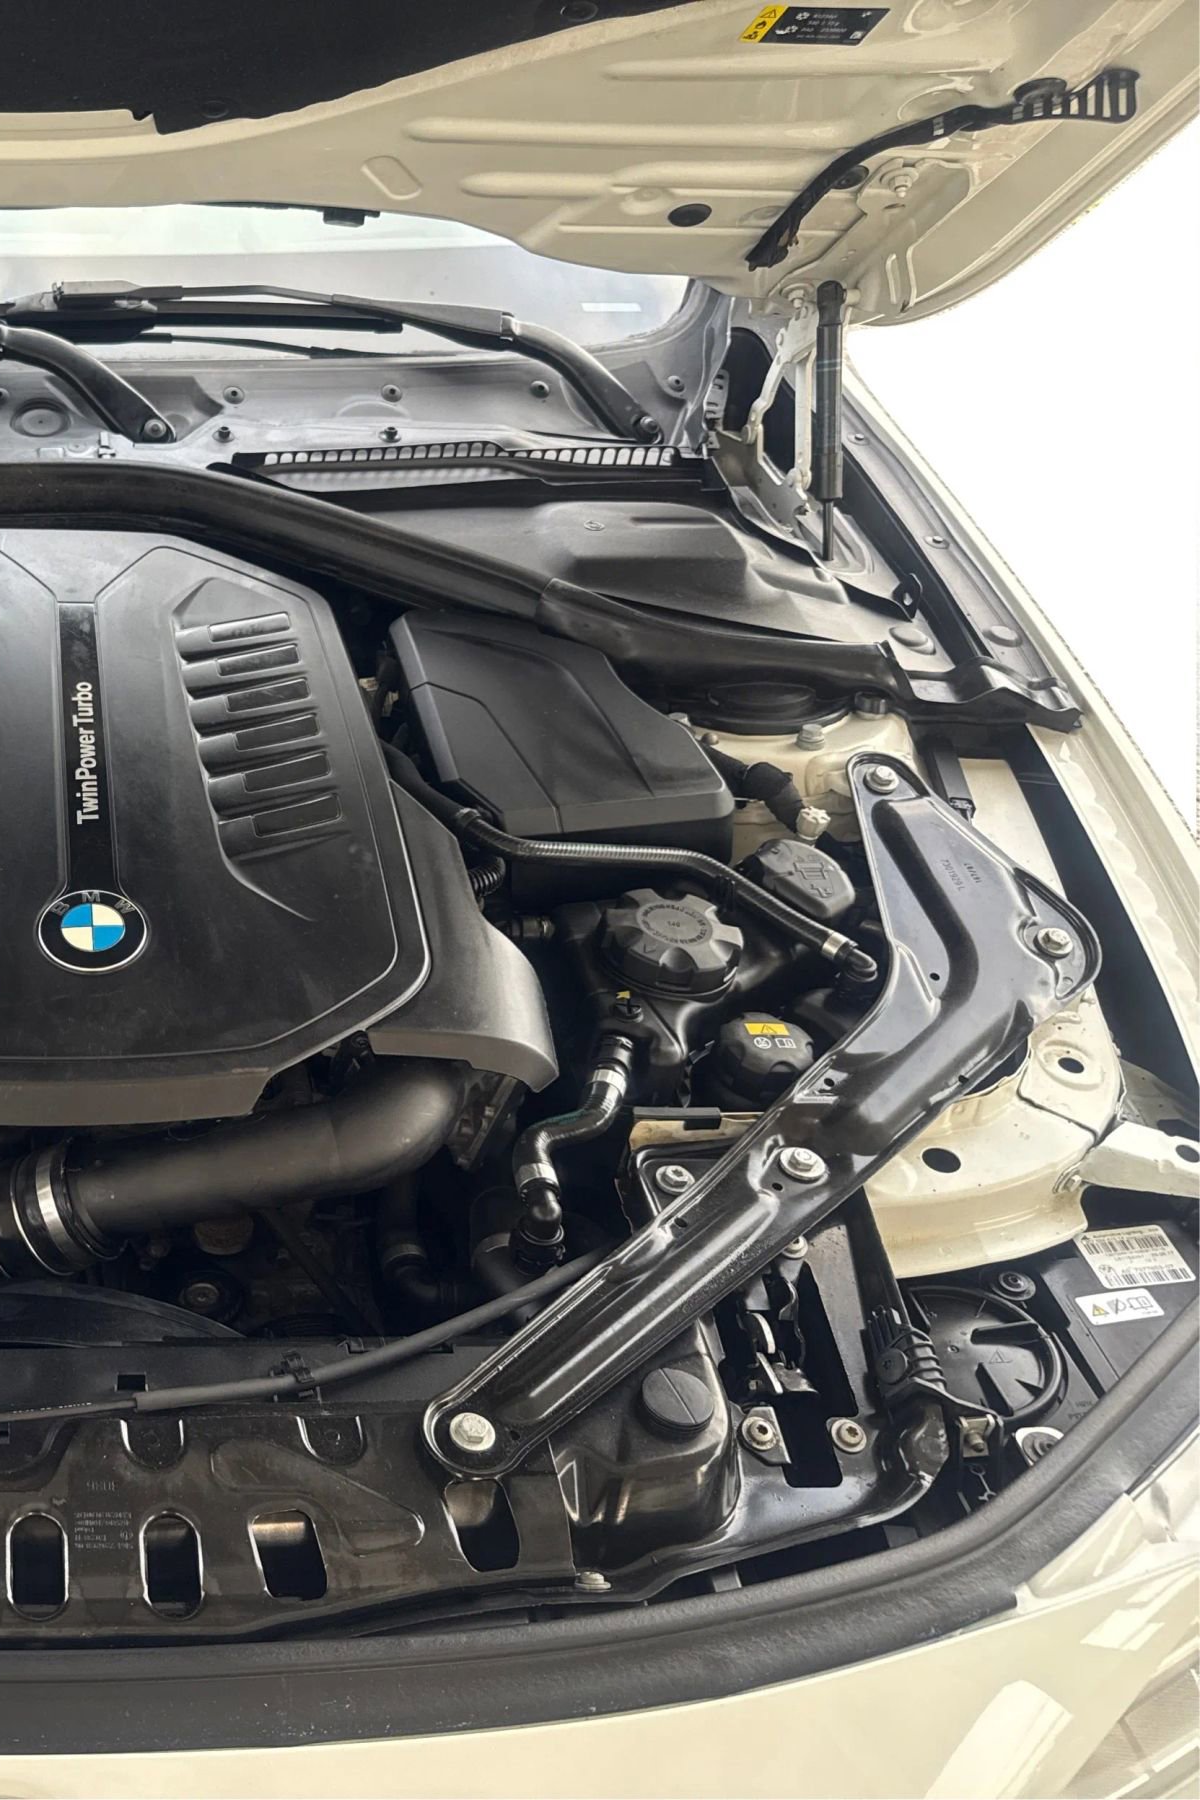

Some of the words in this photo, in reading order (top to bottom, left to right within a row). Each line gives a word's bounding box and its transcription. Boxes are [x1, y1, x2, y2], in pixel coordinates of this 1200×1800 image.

[71, 681, 95, 727] Turbo
[75, 727, 99, 825] TwinPower
[50, 890, 136, 916] BMW
